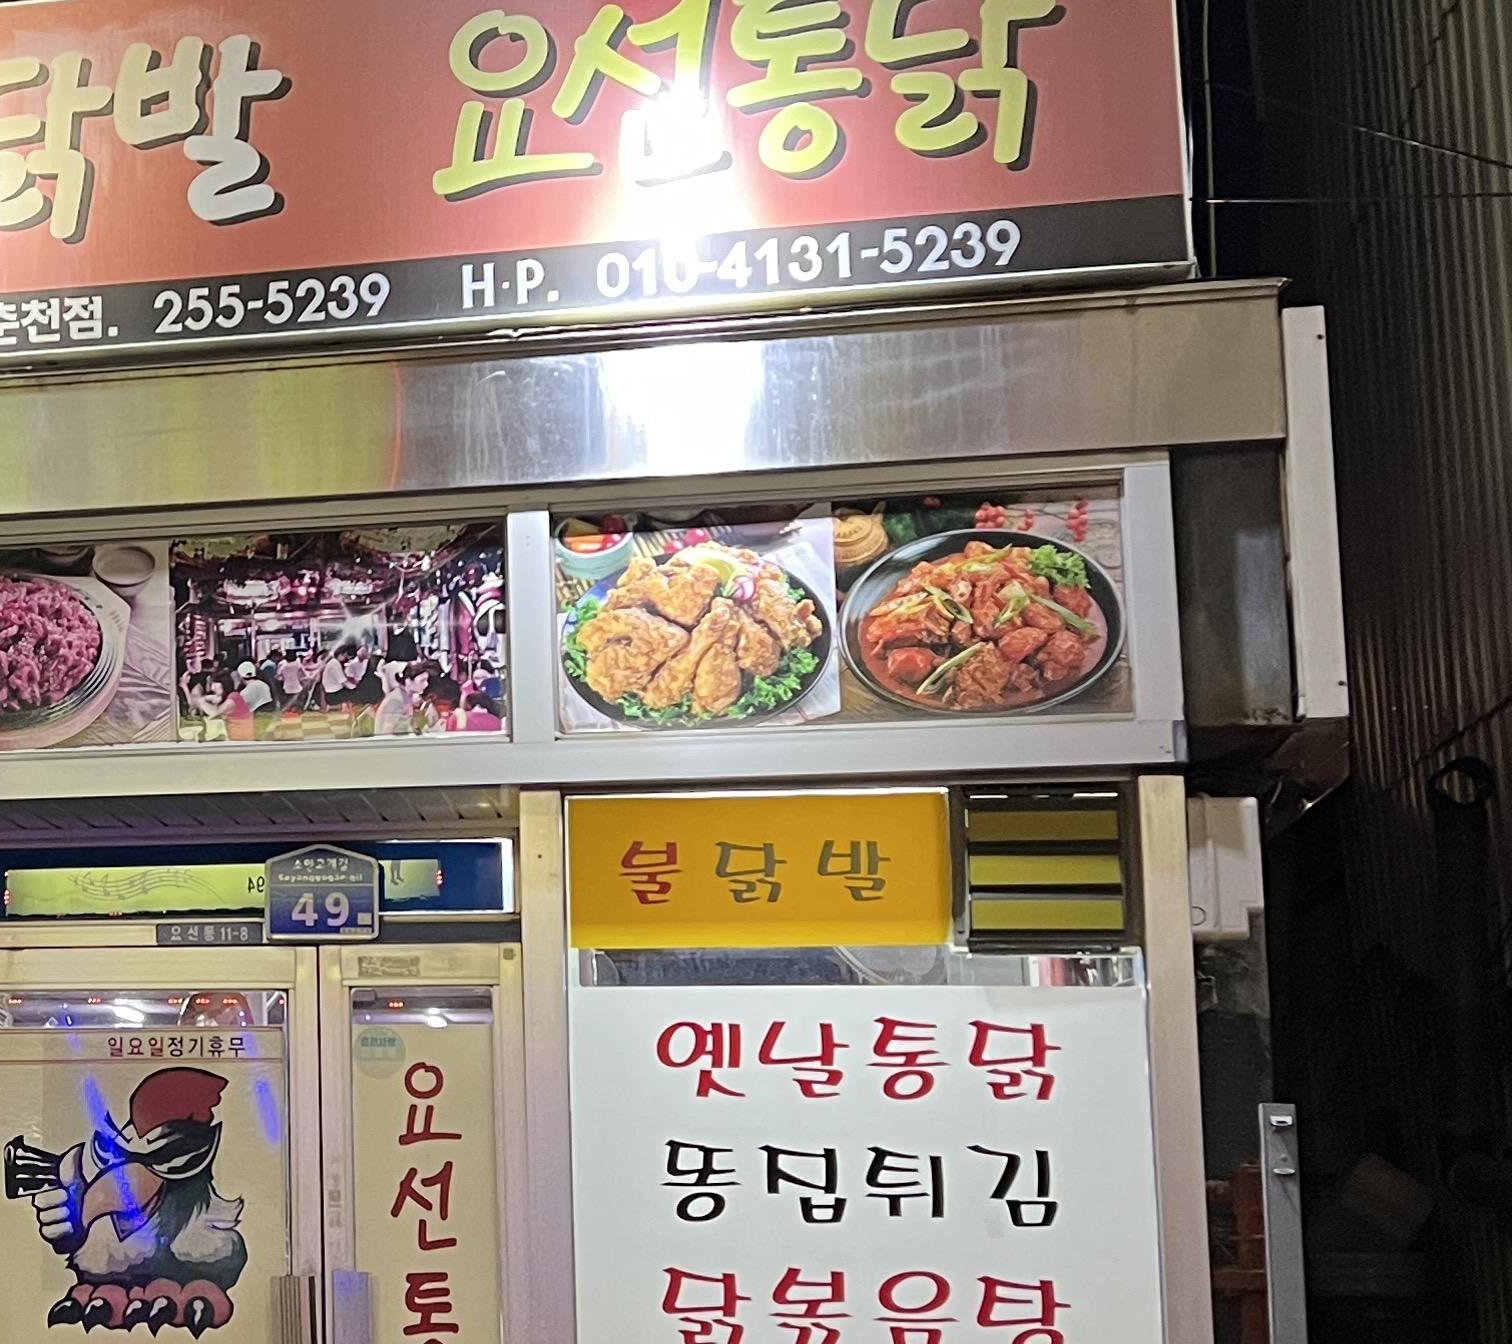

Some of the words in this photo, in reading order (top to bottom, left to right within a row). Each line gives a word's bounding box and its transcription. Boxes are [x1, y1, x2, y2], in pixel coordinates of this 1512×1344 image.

[154, 273, 390, 336] 255-5239
[596, 219, 1021, 300] 010-4131-5239
[220, 926, 249, 942] 11-8
[291, 891, 351, 928] 49
[106, 1035, 247, 1058] 일요일정기휴무
[656, 1015, 1062, 1101] 옛날통닭
[660, 1139, 1058, 1227] 똥집튀김
